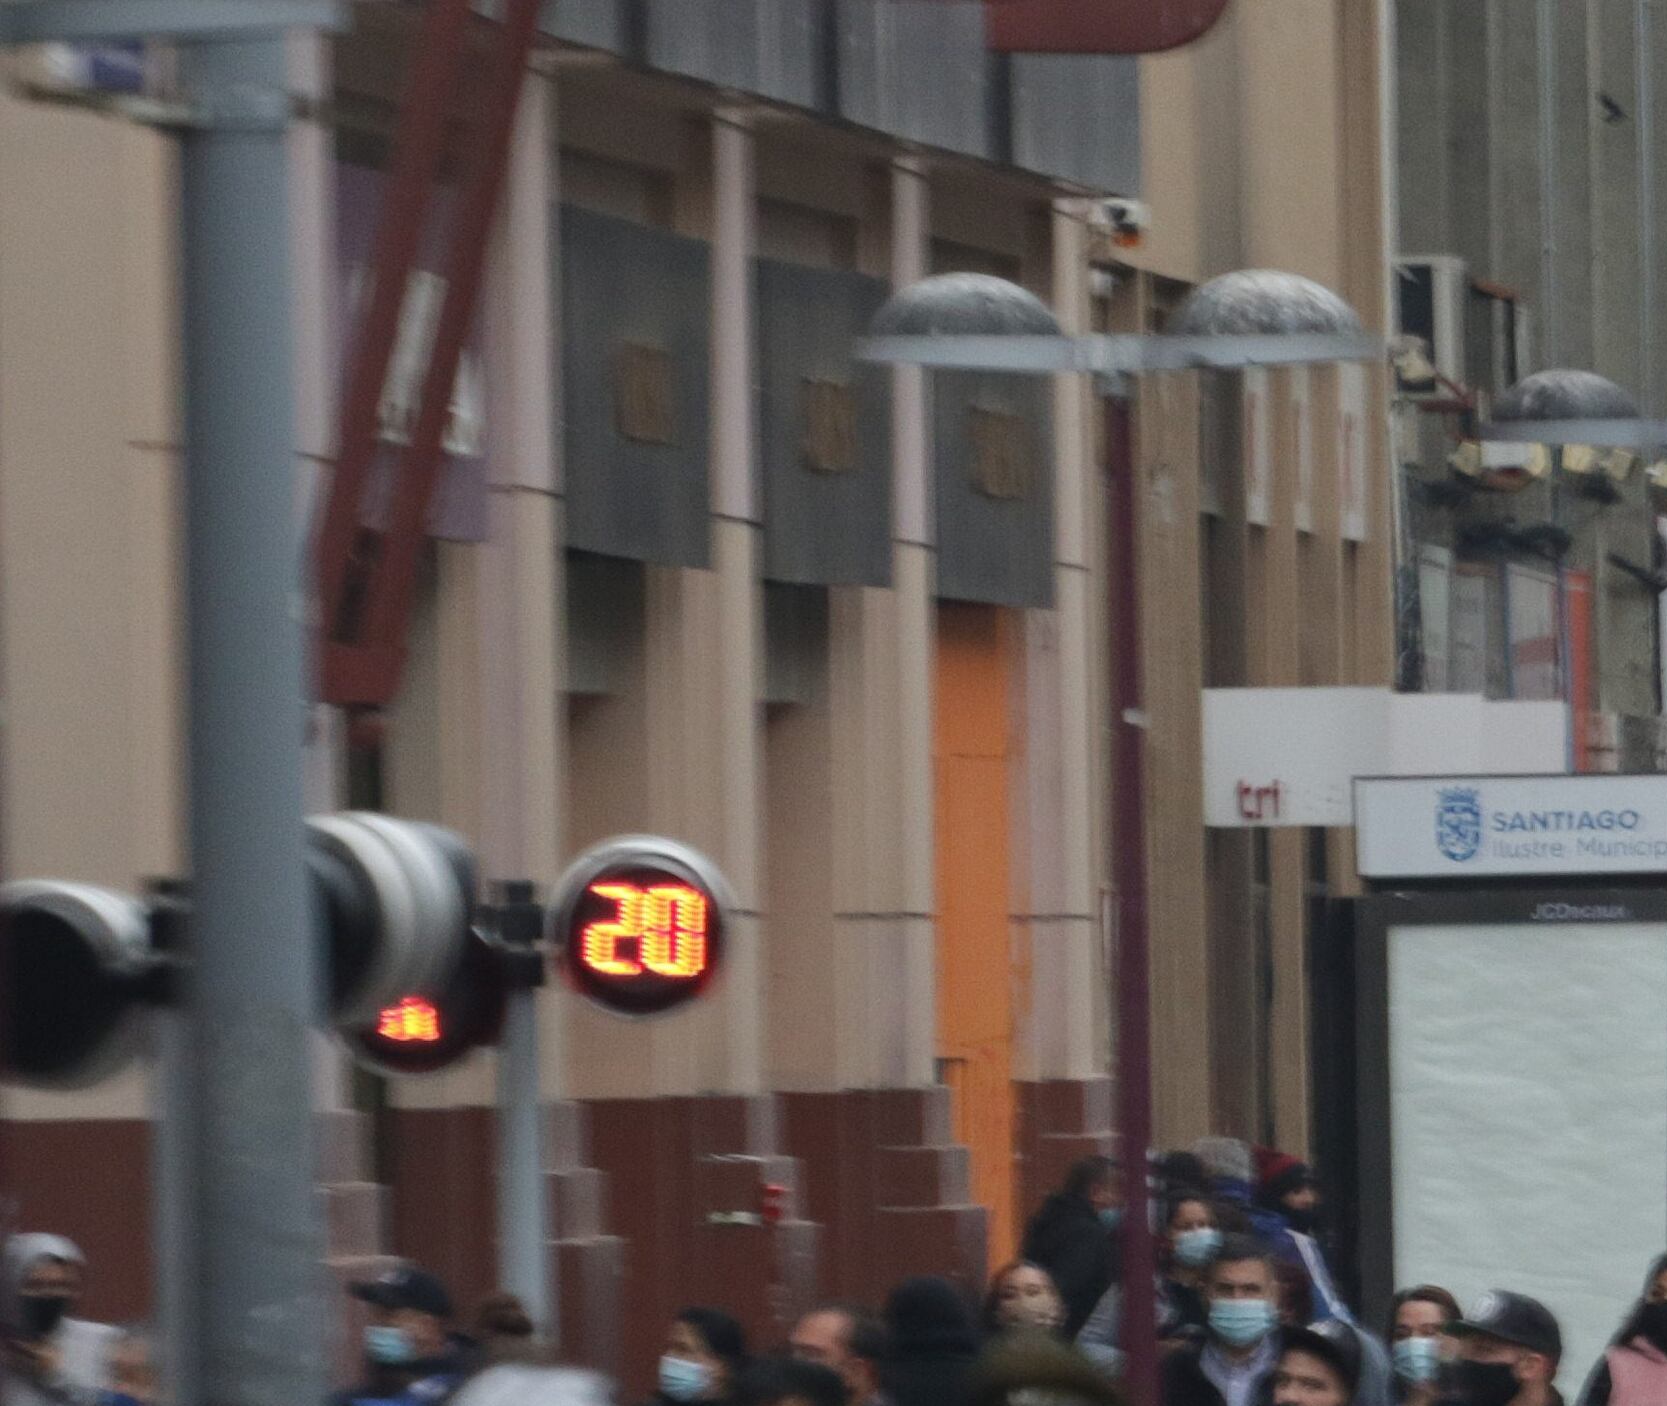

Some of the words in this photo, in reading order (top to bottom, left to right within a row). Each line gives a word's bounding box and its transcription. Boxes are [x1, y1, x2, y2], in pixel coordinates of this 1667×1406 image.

[1492, 809, 1640, 832] SANTIAGO
[1491, 839, 1566, 859] Ilustre
[583, 883, 706, 977] 20
